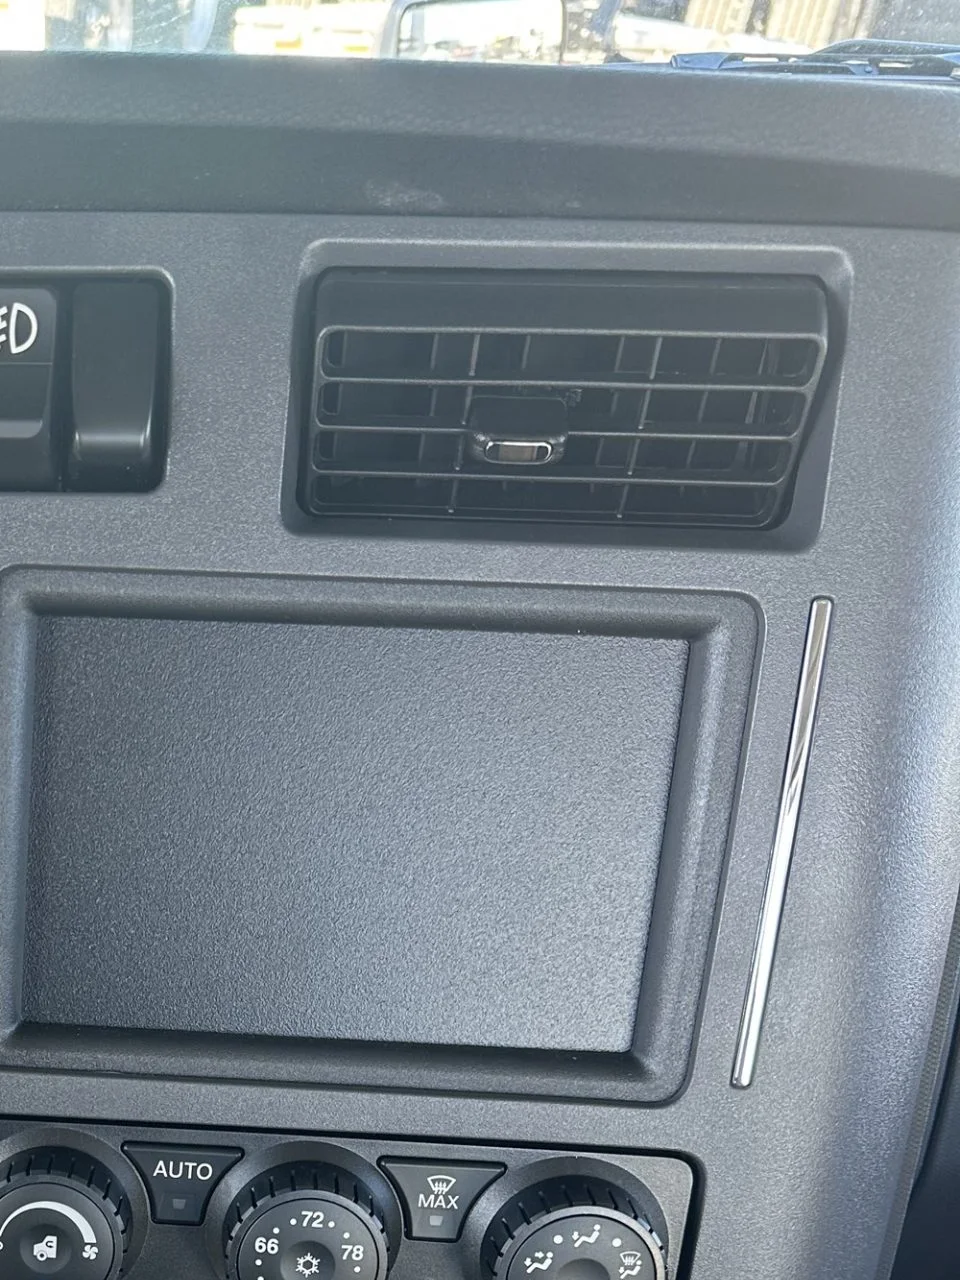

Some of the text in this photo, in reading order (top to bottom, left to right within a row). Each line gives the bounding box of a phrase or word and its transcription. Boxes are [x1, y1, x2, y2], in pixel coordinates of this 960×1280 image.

[153, 1161, 213, 1181] AUTO
[418, 1194, 460, 1209] MAX
[301, 1211, 325, 1228] 72
[255, 1237, 279, 1255] 66
[342, 1245, 364, 1261] 78
